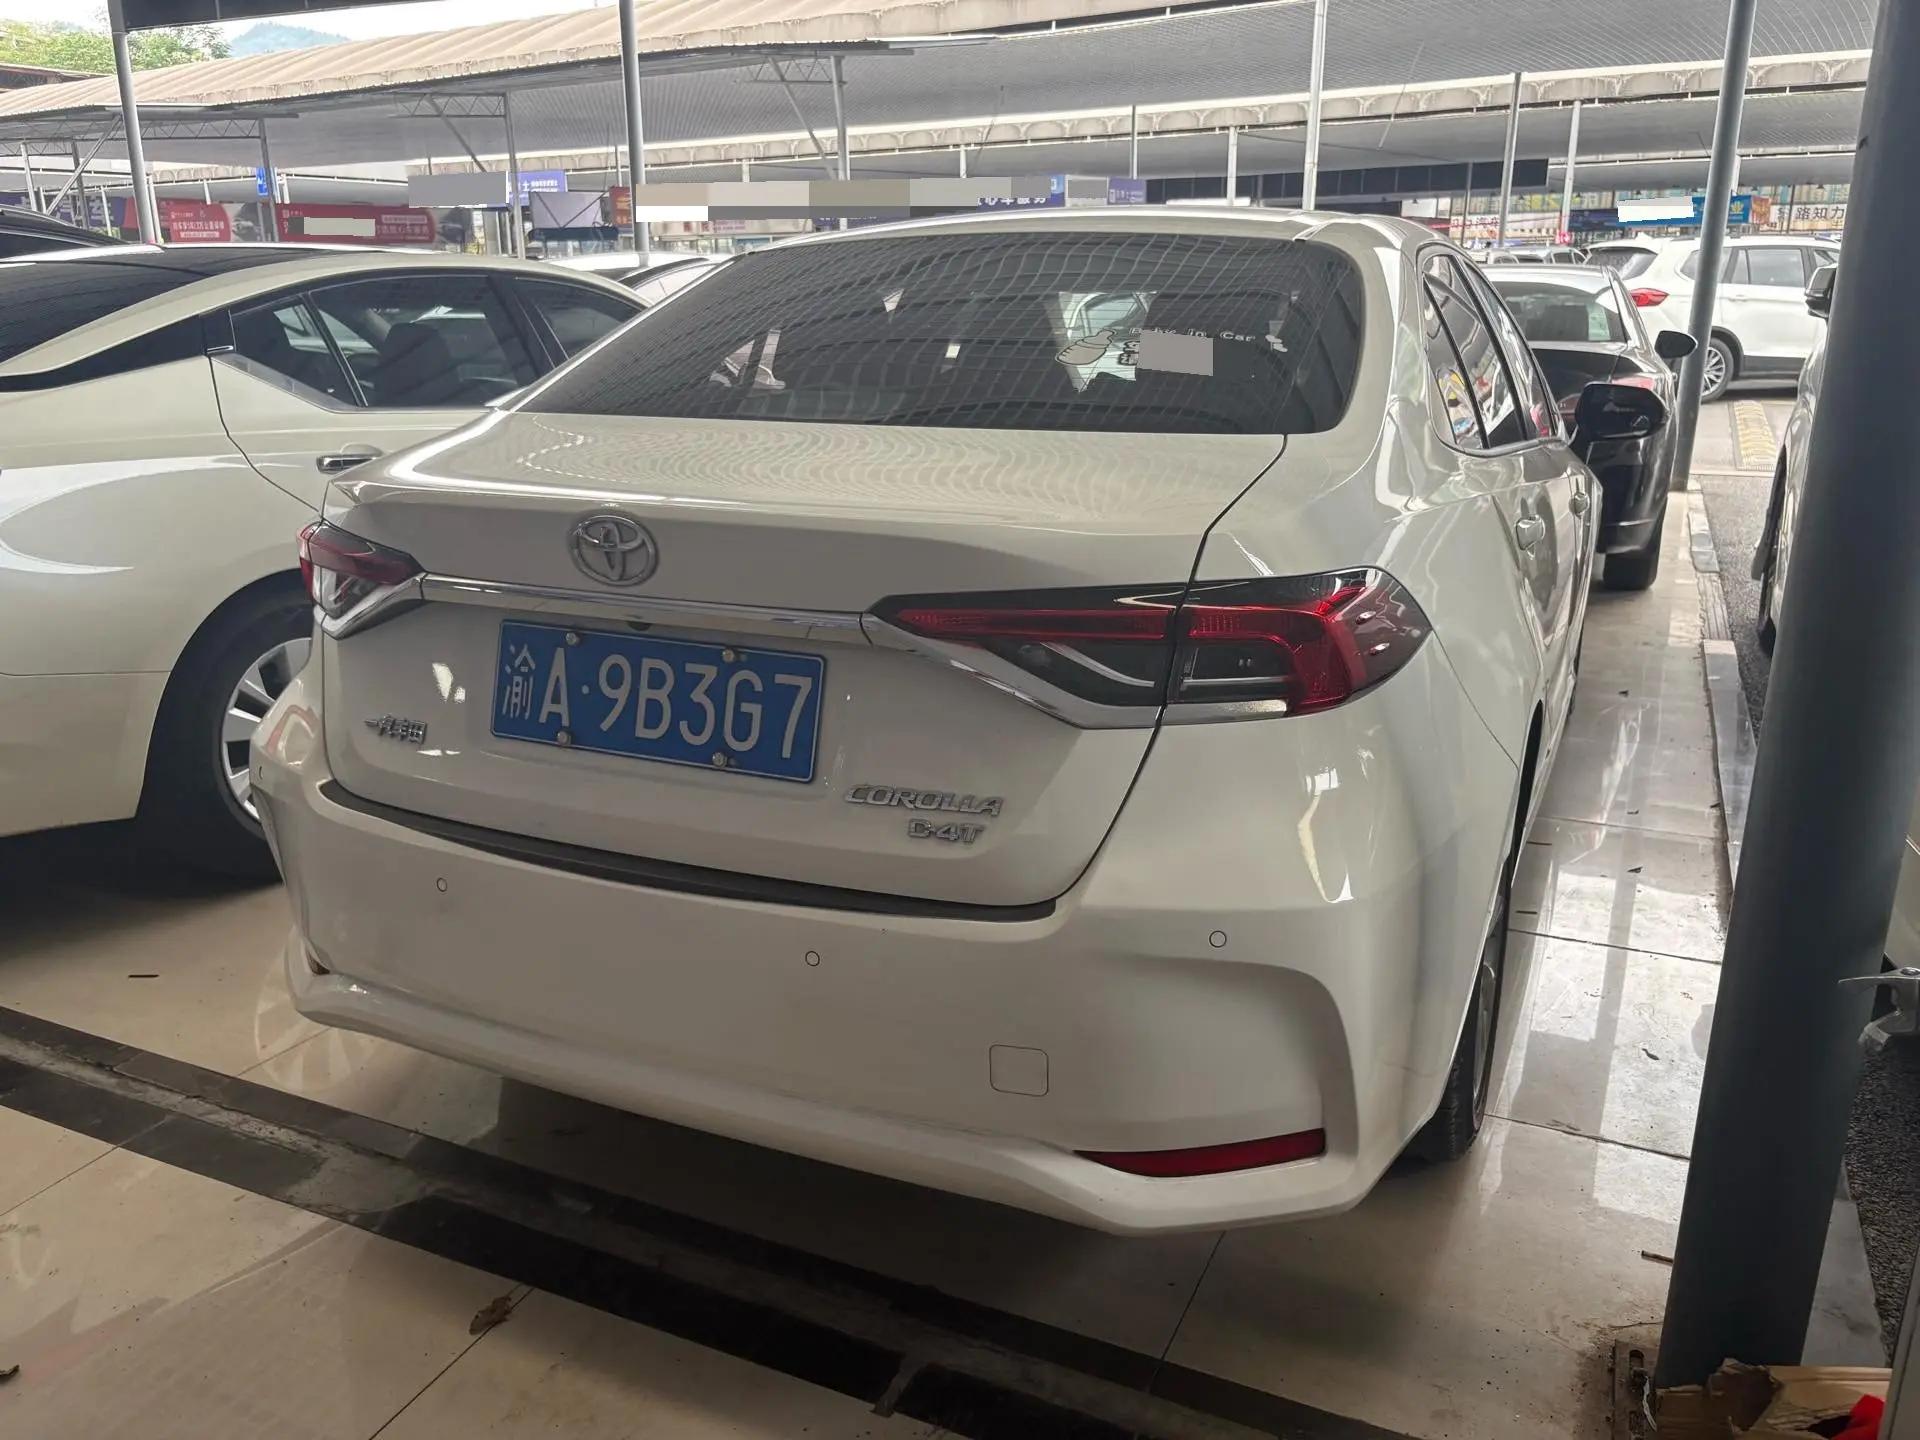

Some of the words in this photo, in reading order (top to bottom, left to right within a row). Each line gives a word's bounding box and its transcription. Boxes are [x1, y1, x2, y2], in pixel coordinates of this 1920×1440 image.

[1795, 206, 1845, 220] 路知力
[1221, 331, 1255, 342] Car
[845, 783, 1004, 817] COROLLA
